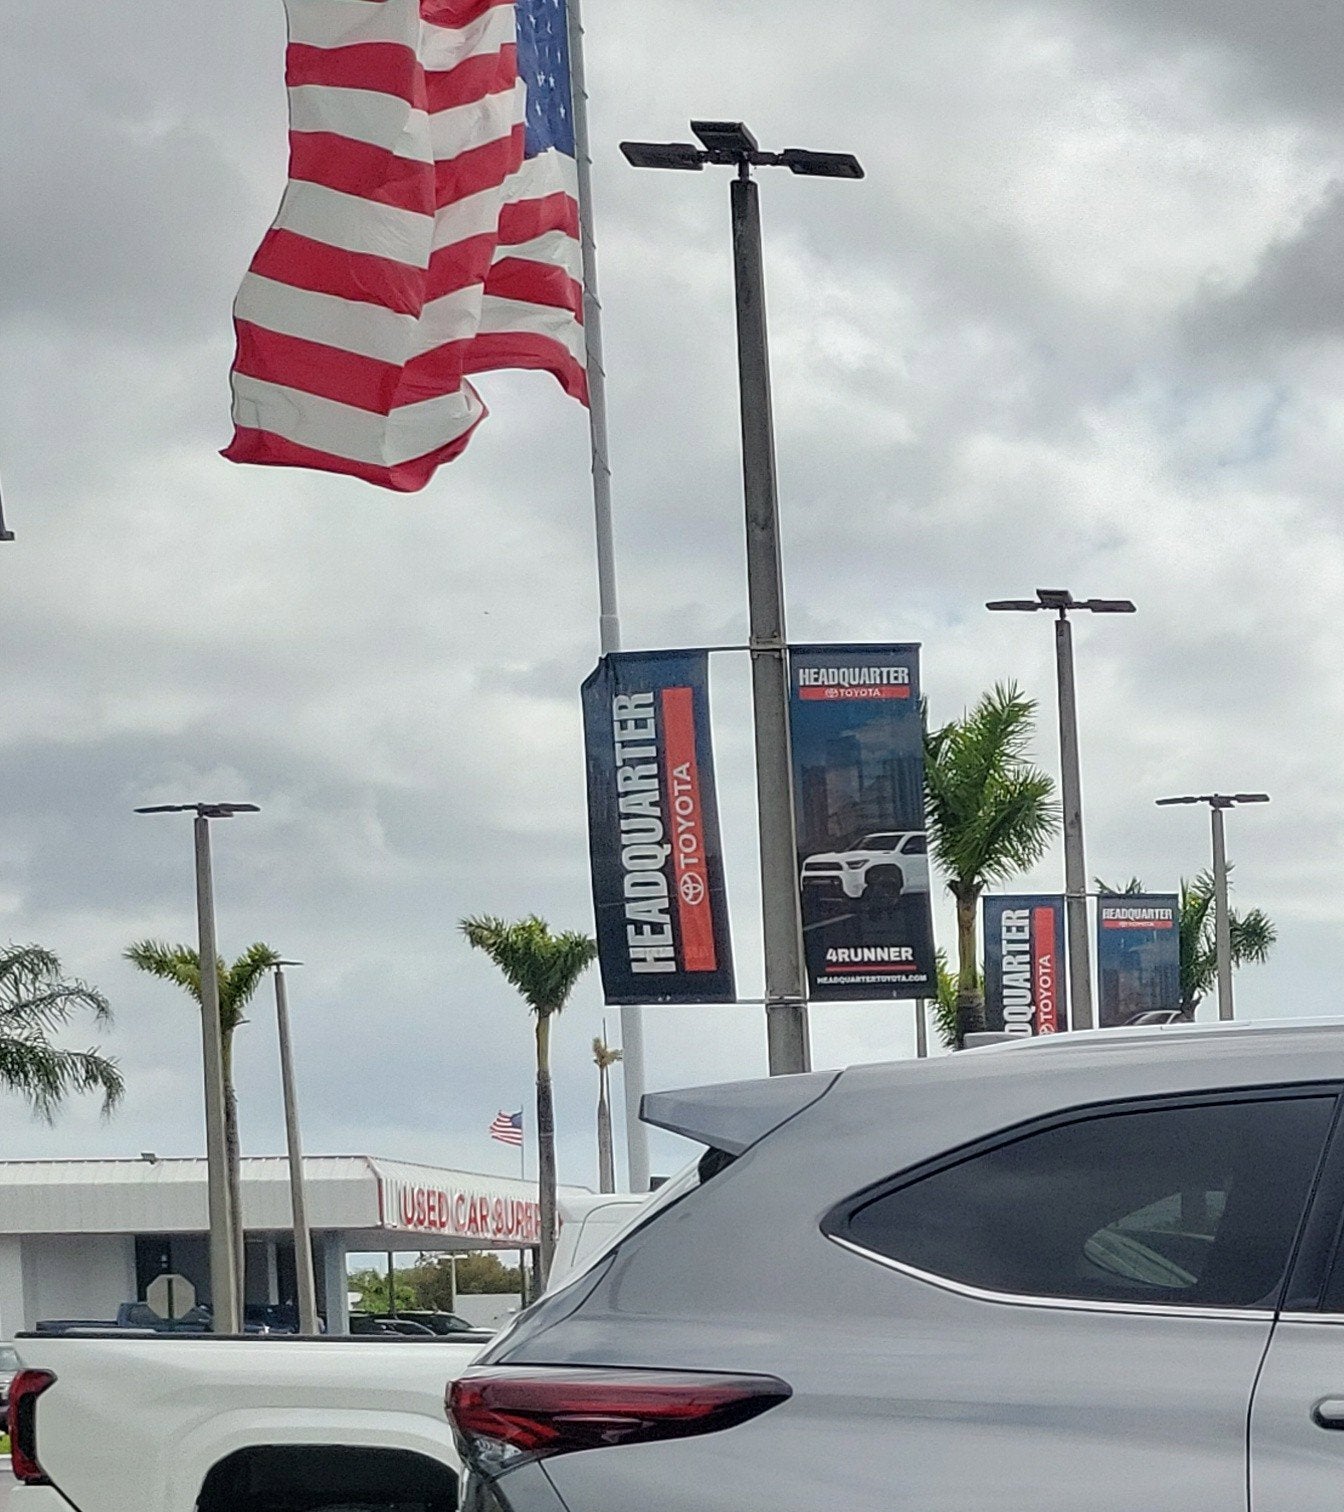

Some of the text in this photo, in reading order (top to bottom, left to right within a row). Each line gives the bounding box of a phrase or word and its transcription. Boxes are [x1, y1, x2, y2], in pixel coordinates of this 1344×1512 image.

[799, 667, 909, 687] HEADQUARTER
[840, 688, 881, 697] TOYOTA
[613, 691, 677, 973] HEADQUARTER
[672, 762, 701, 870] TOYOTA
[1103, 908, 1172, 921] HEADQUARTER
[826, 947, 913, 962] 4RUNNER
[1039, 954, 1053, 1022] TOYOTA
[402, 1185, 449, 1229] USED
[454, 1192, 490, 1235] CAR
